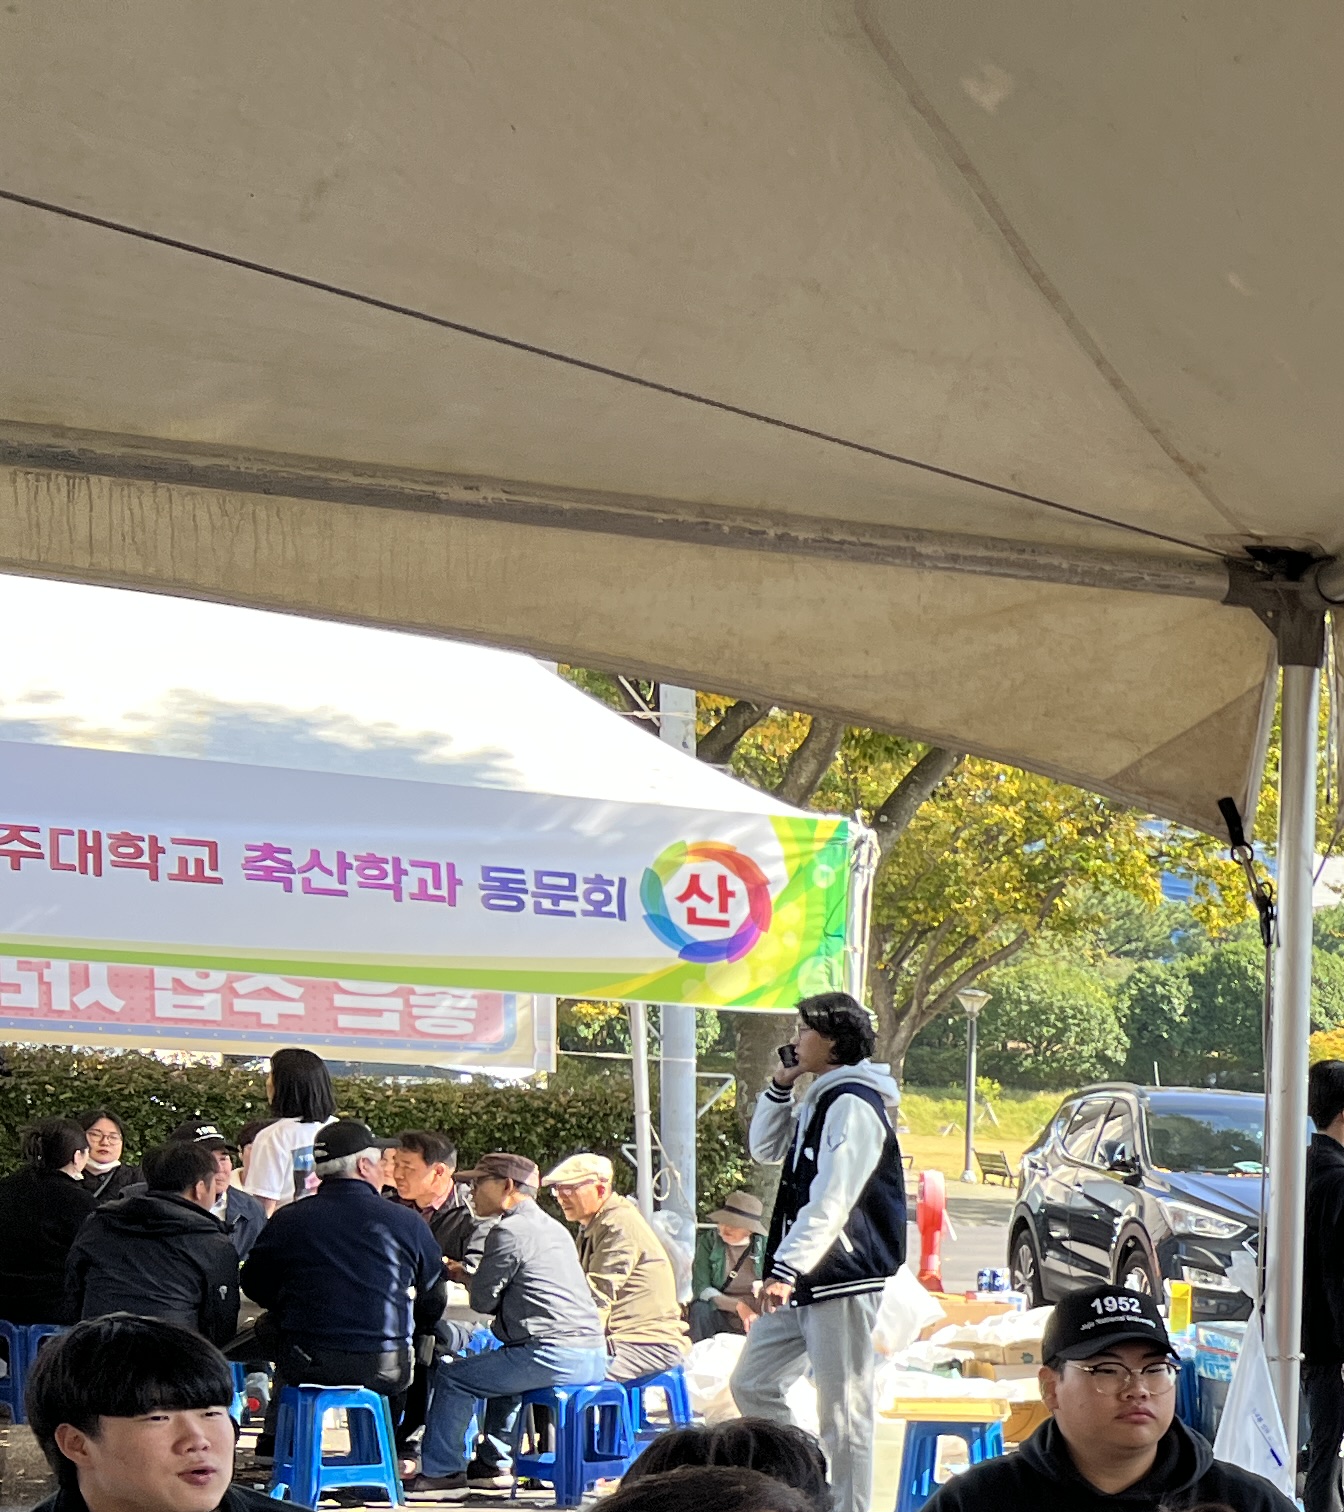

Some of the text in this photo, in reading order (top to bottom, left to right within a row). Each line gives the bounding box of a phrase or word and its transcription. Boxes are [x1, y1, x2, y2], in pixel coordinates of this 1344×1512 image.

[0, 824, 627, 921] 주대학교 축산학과 동문회
[676, 873, 736, 928] 산
[1090, 1295, 1142, 1315] 1952
